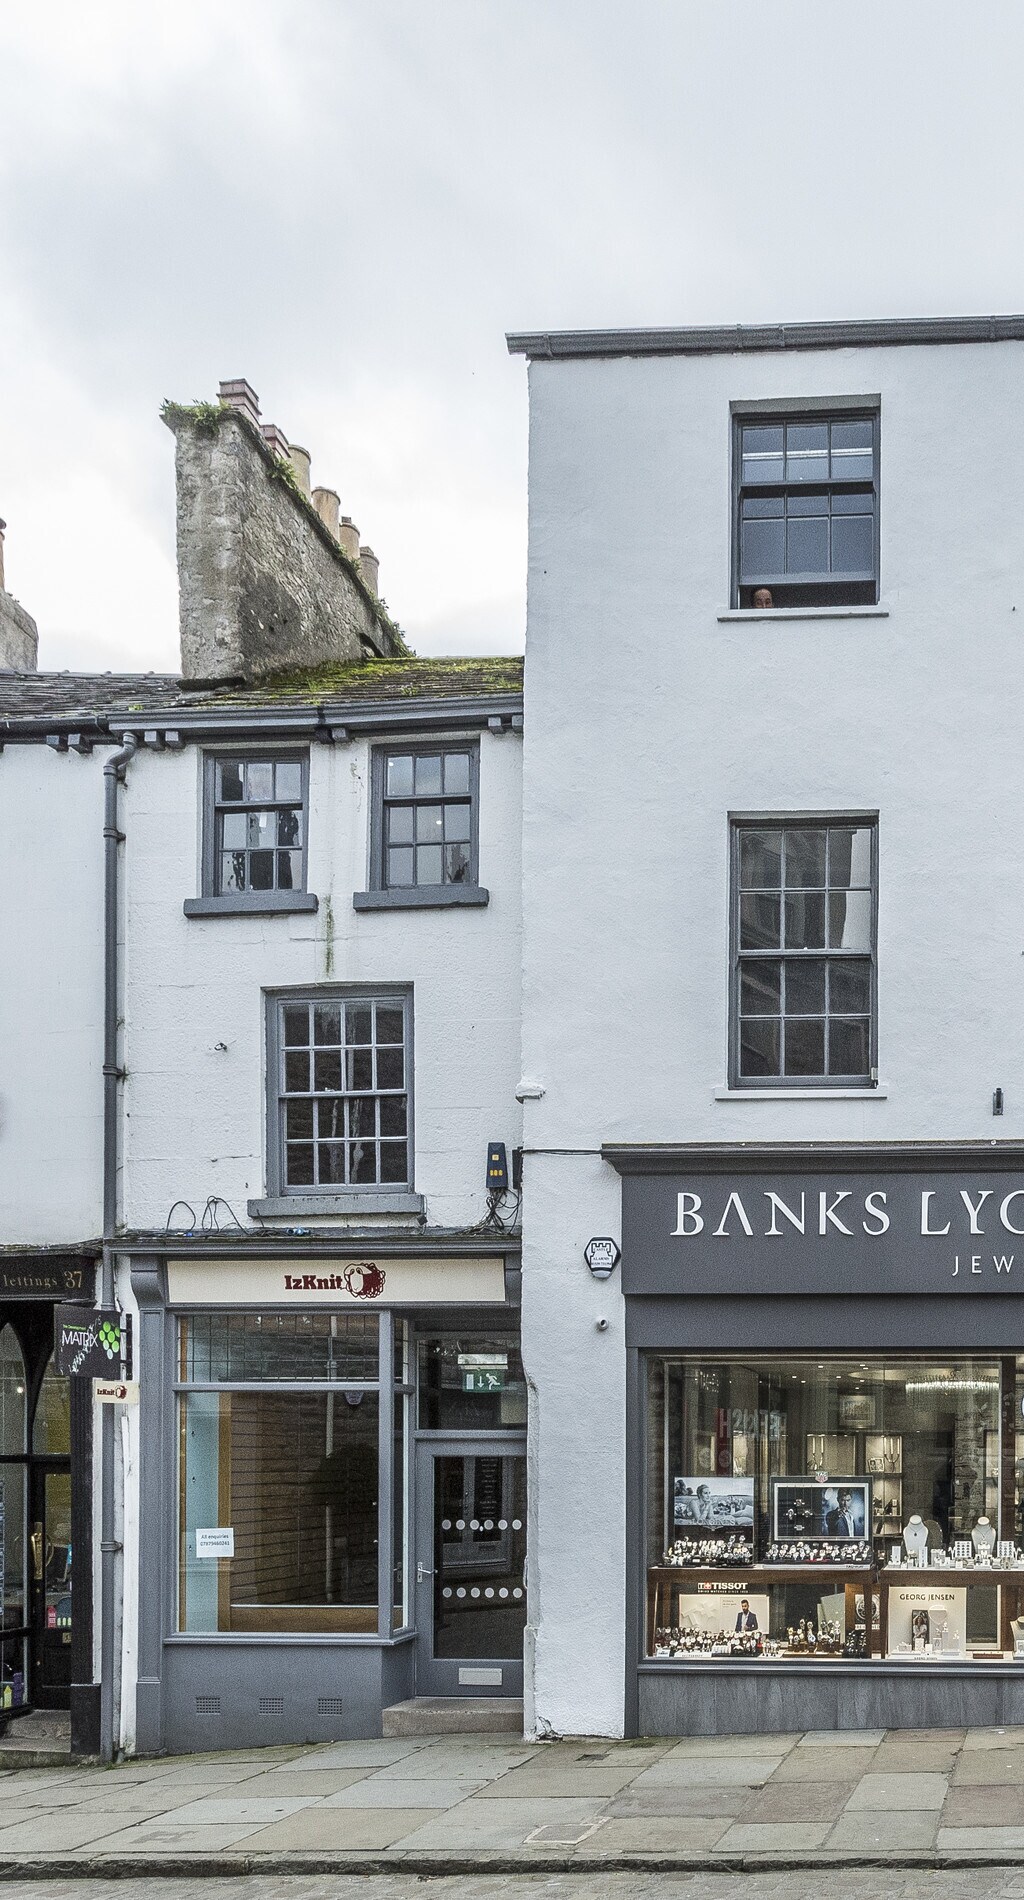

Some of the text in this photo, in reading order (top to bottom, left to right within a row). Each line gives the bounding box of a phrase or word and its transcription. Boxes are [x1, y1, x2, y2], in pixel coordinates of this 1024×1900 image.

[670, 1191, 891, 1236] BANKS
[3, 1271, 82, 1288] lettings 37
[284, 1274, 343, 1290] IzKnit
[62, 1330, 98, 1347] MATRIX
[97, 1388, 115, 1396] IzKnit
[711, 1582, 748, 1590] TISSOT
[899, 1593, 955, 1601] GEORG JENSEN
